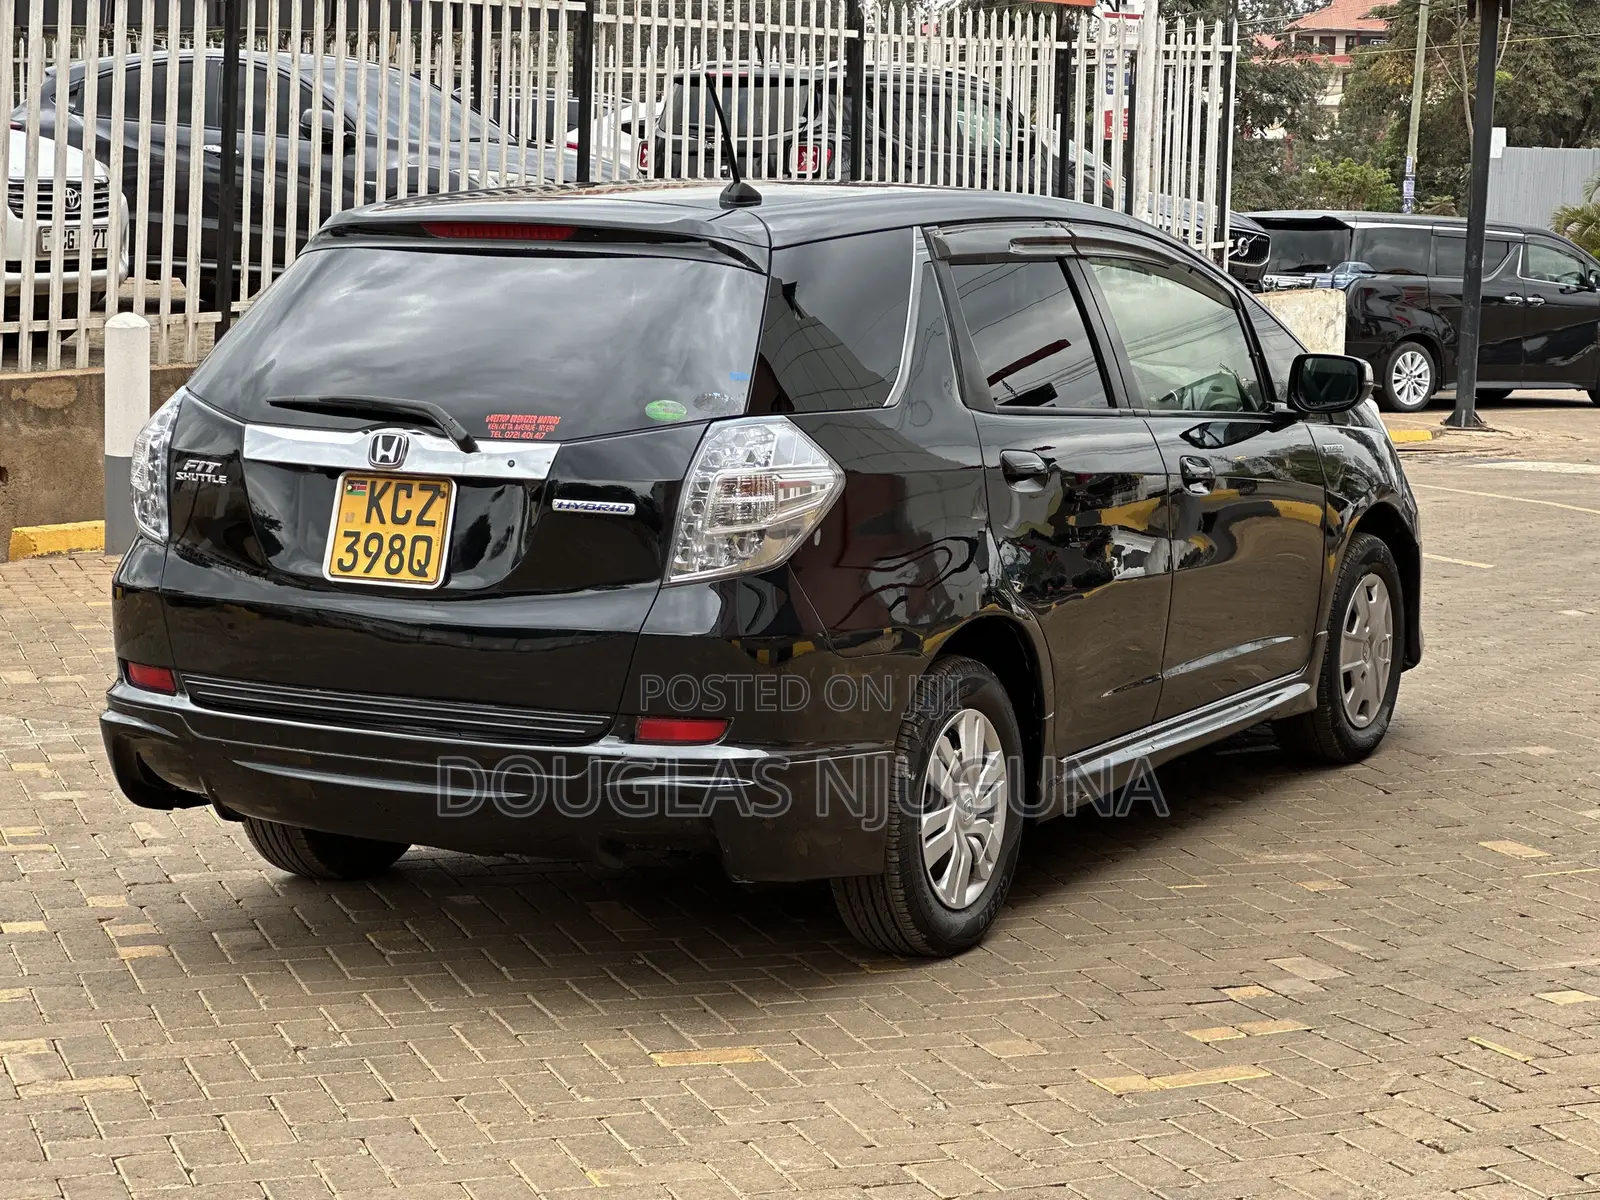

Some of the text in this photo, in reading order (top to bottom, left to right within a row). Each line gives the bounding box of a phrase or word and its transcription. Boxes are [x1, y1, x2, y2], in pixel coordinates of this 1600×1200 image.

[183, 459, 222, 473] FIT
[175, 471, 227, 484] SHUTTLE
[365, 481, 441, 527] KCZ
[556, 502, 630, 513] HYBRID
[337, 530, 433, 577] 398Q
